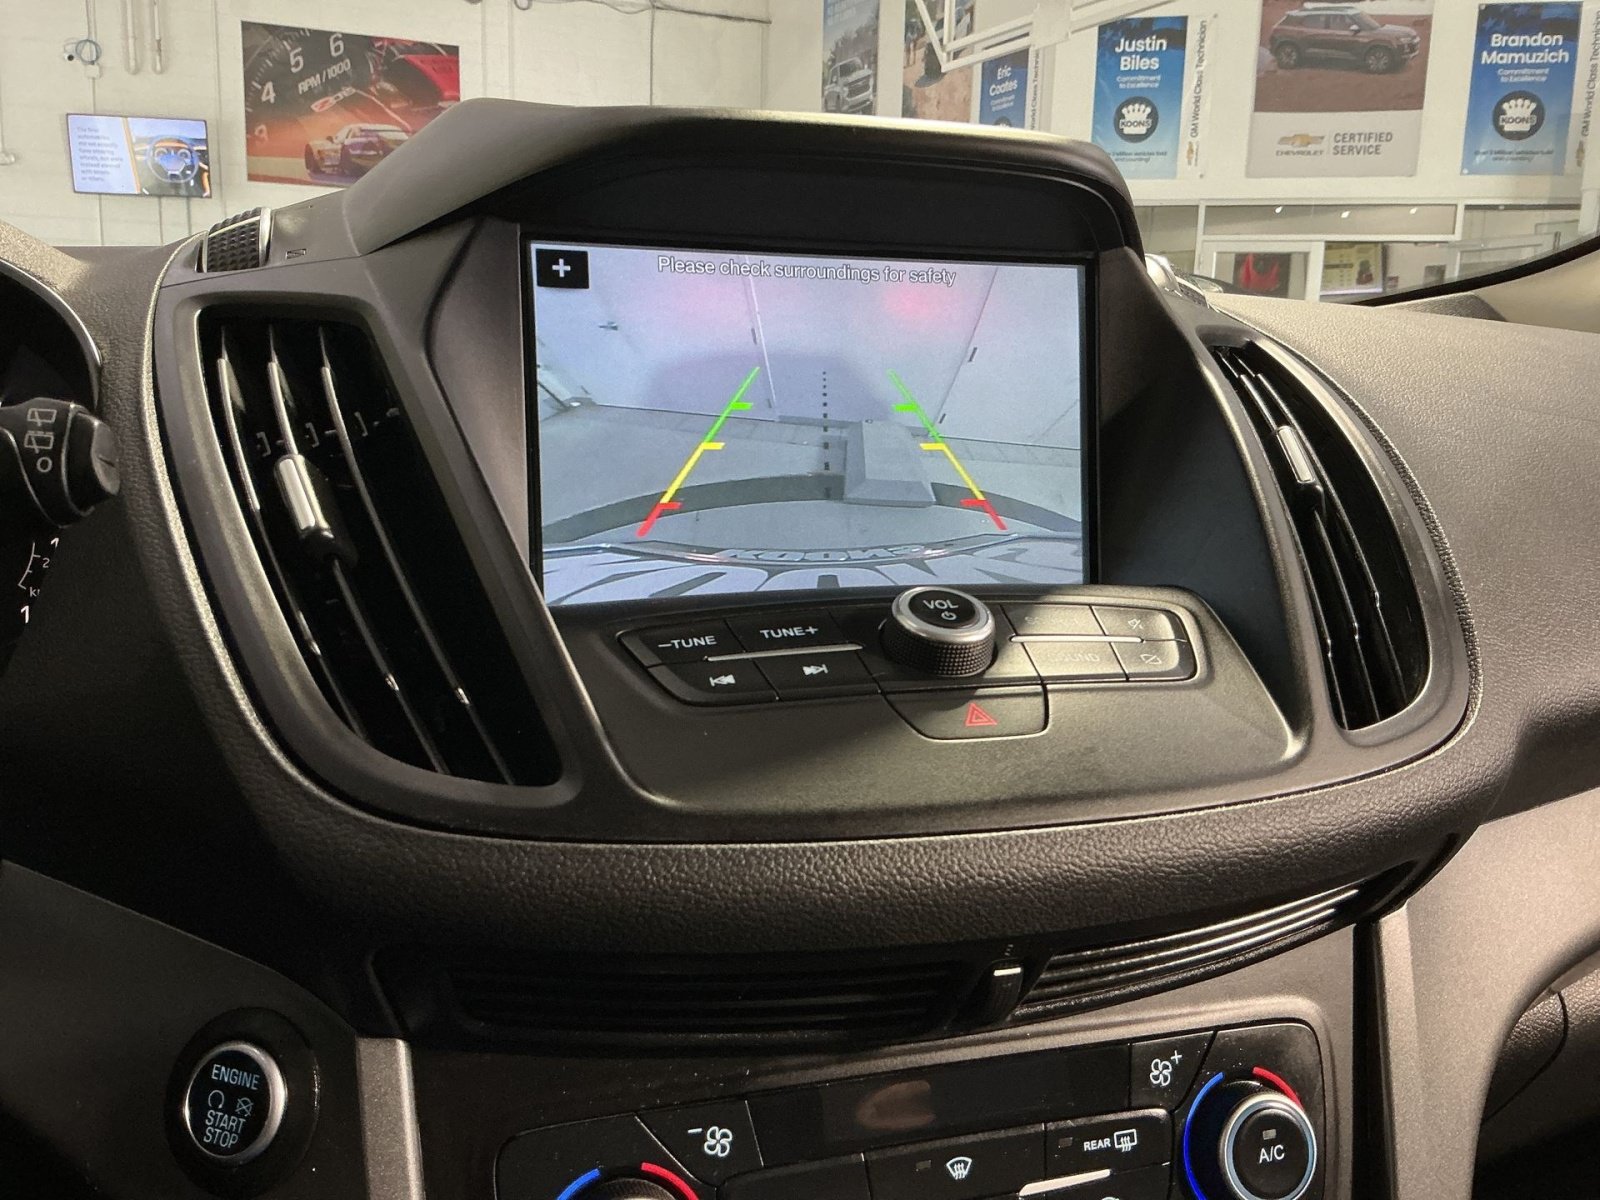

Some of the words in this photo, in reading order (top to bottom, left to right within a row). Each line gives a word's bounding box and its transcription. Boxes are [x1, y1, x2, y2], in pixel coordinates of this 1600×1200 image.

[330, 32, 344, 57] 6
[1115, 35, 1167, 53] Justin
[1491, 32, 1564, 48] Brandon
[290, 47, 304, 73] 5
[1120, 54, 1160, 71] Biles
[1481, 48, 1570, 65] Mamuzich
[997, 65, 1012, 80] Eric
[1587, 63, 1598, 90] Class
[261, 81, 276, 104] 4
[989, 80, 1018, 96] Coates
[1120, 120, 1151, 128] KOONS
[1501, 116, 1537, 124] KOONS
[1333, 132, 1393, 144] CERTIFIED
[1332, 144, 1382, 156] SERVICE
[657, 256, 715, 274] Please
[719, 259, 771, 278] check
[774, 265, 881, 284] surroundings
[884, 266, 906, 282] for
[909, 268, 957, 287] safety
[923, 599, 959, 609] VOL
[211, 1064, 261, 1091] ENGINE
[205, 1110, 246, 1133] START
[203, 1127, 239, 1149] STOP
[1083, 1137, 1111, 1151] REAR
[1258, 1144, 1285, 1164] A/C
